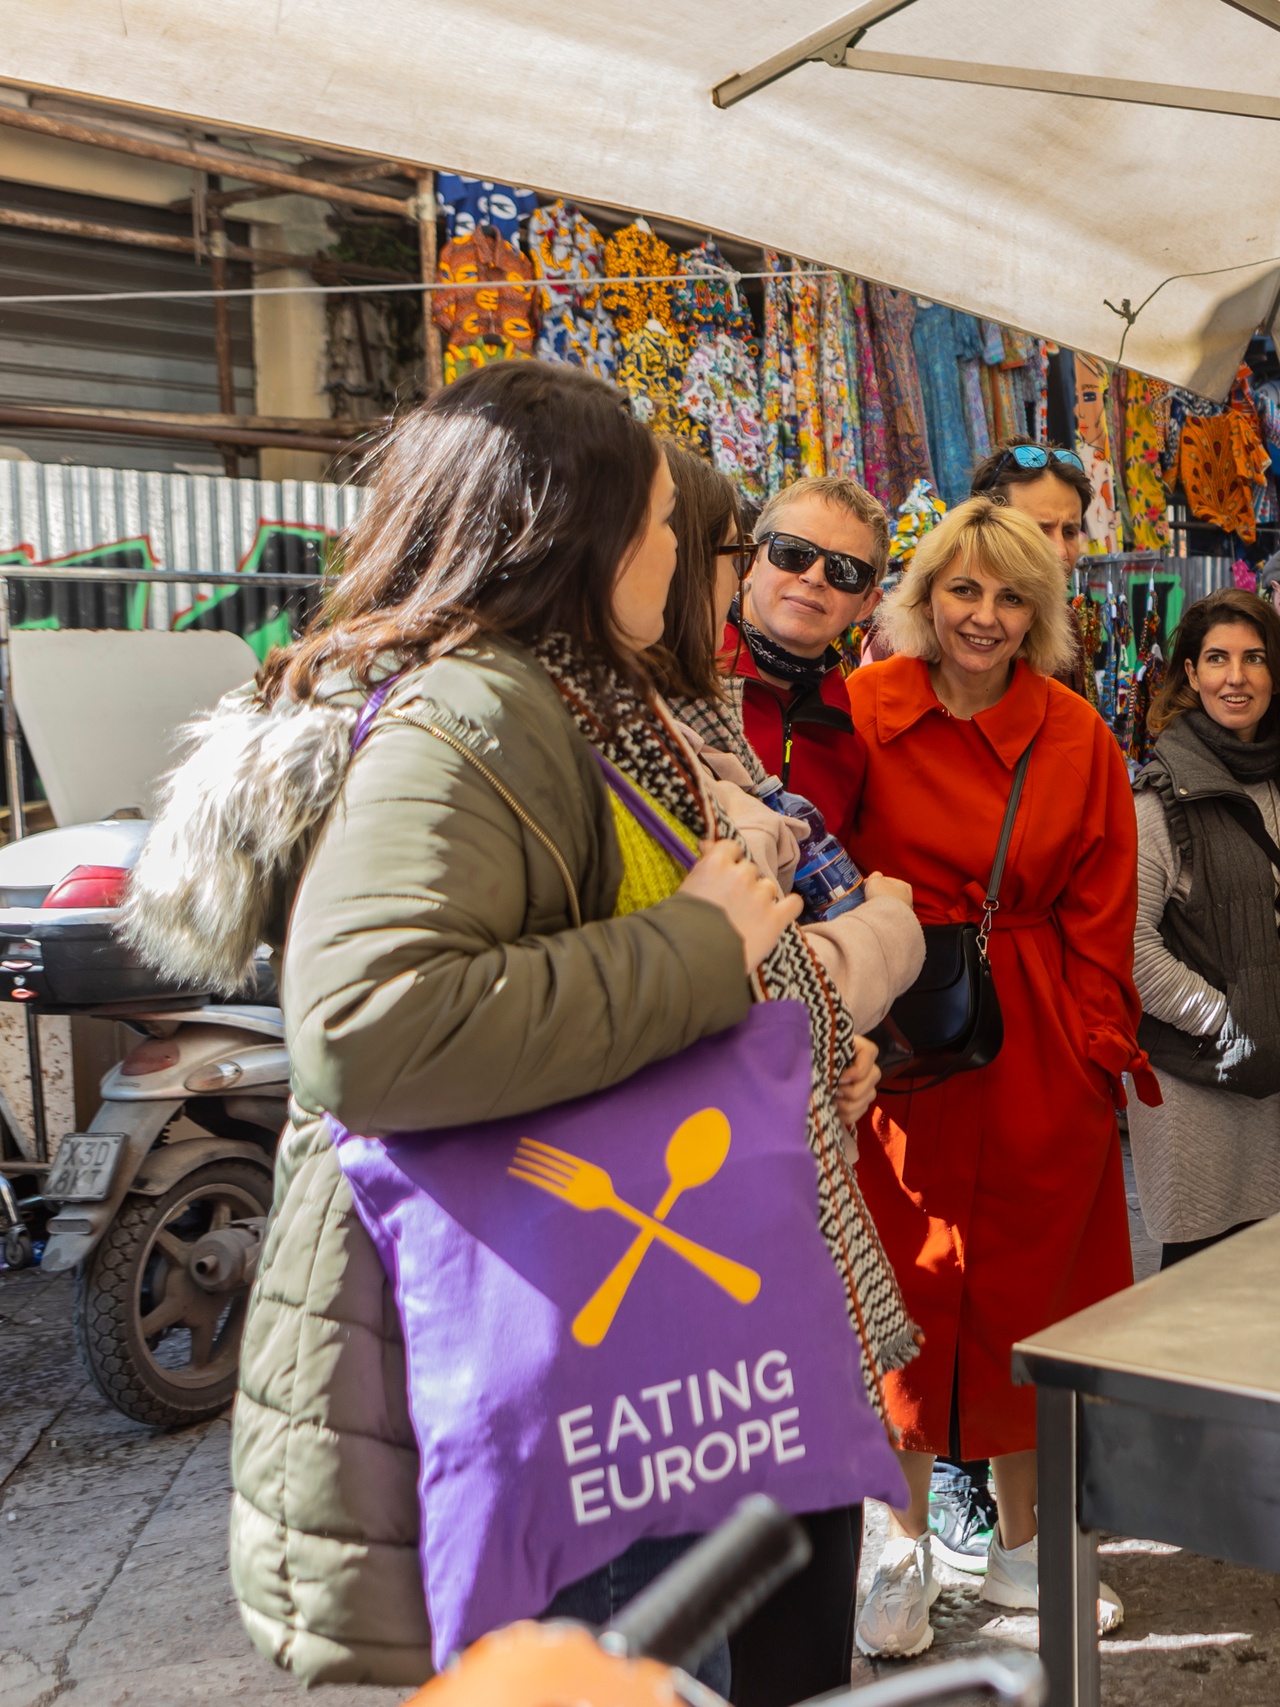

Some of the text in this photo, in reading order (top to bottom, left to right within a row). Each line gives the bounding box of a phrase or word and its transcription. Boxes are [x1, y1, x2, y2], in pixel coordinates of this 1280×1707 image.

[63, 1141, 110, 1166] X3D
[558, 1349, 795, 1466] EATING
[570, 1406, 806, 1526] EUROPE
